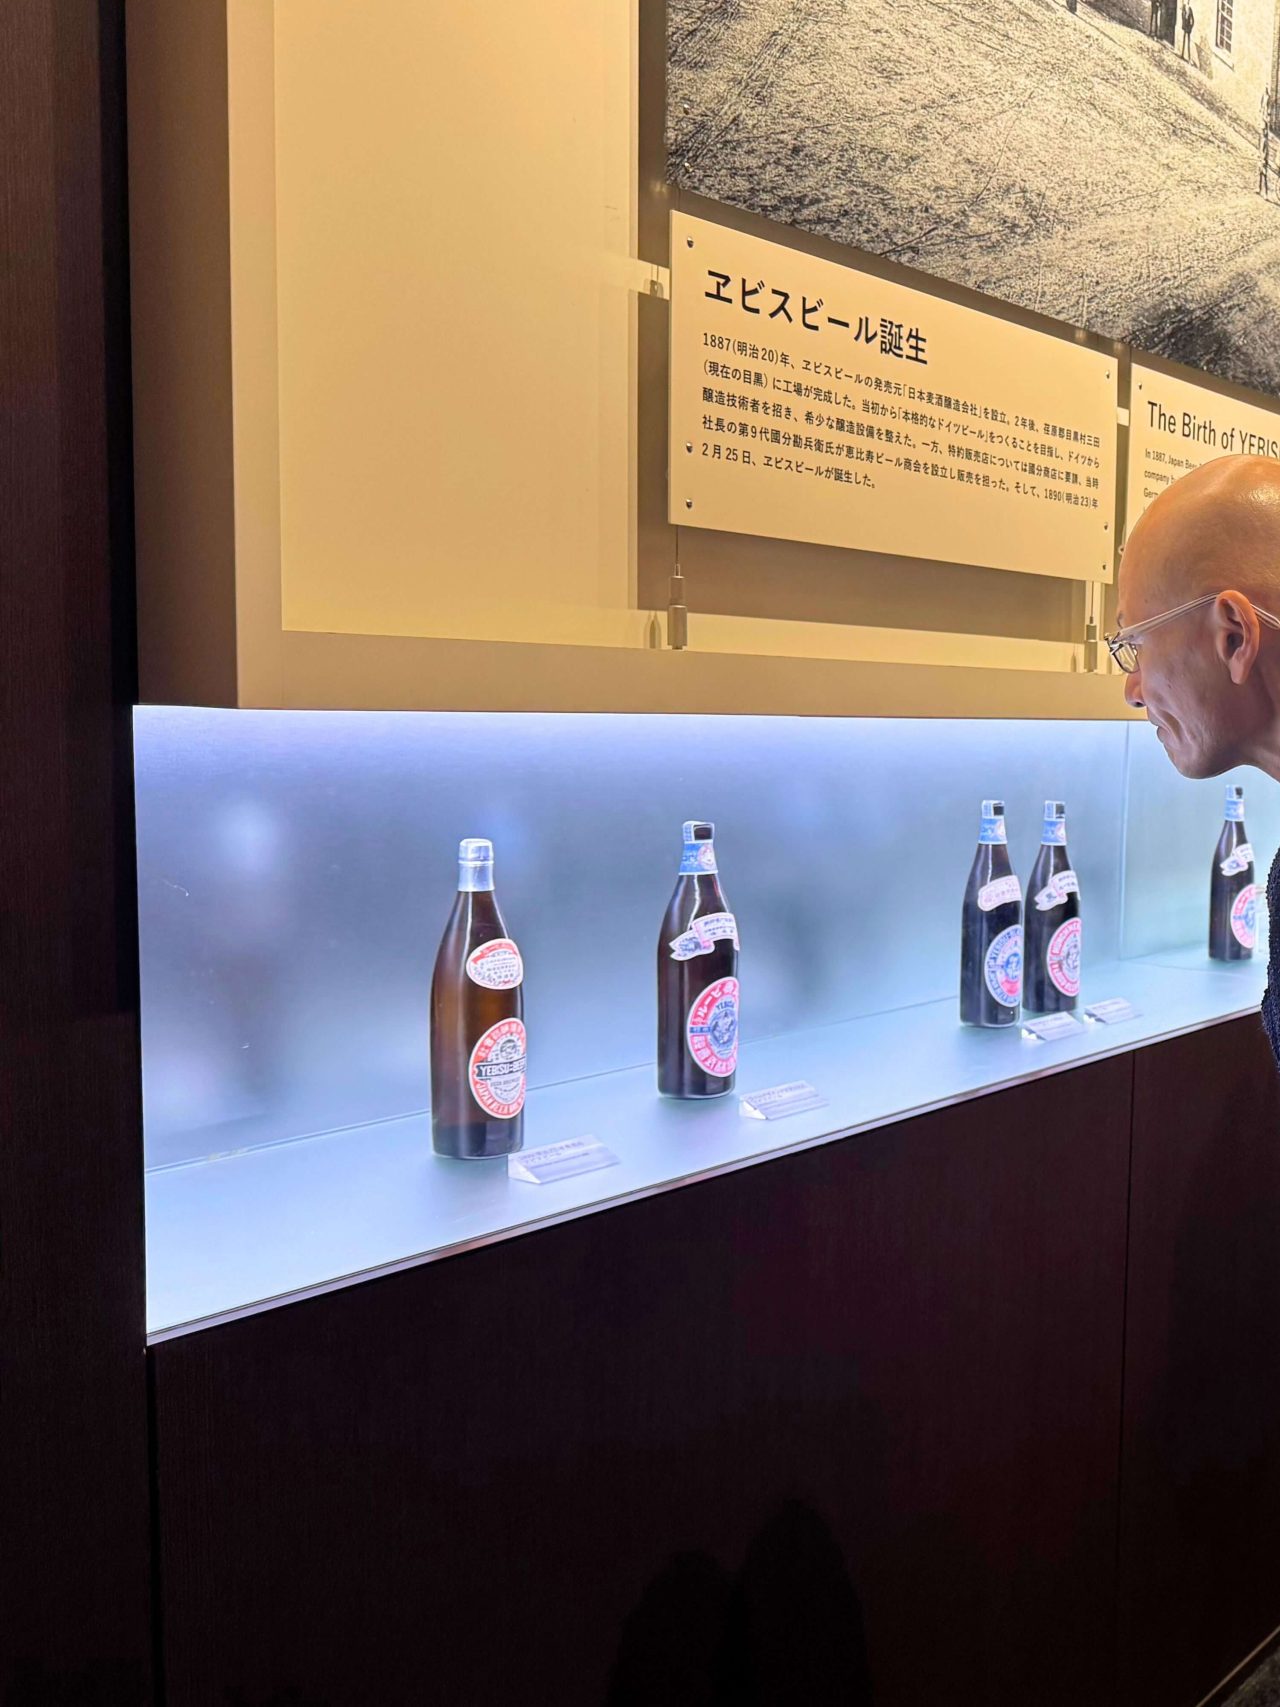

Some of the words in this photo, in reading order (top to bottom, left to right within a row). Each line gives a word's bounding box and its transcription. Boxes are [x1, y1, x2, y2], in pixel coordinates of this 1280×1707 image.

[1147, 401, 1176, 434] The
[1182, 412, 1216, 447] Birth
[1221, 427, 1235, 451] of
